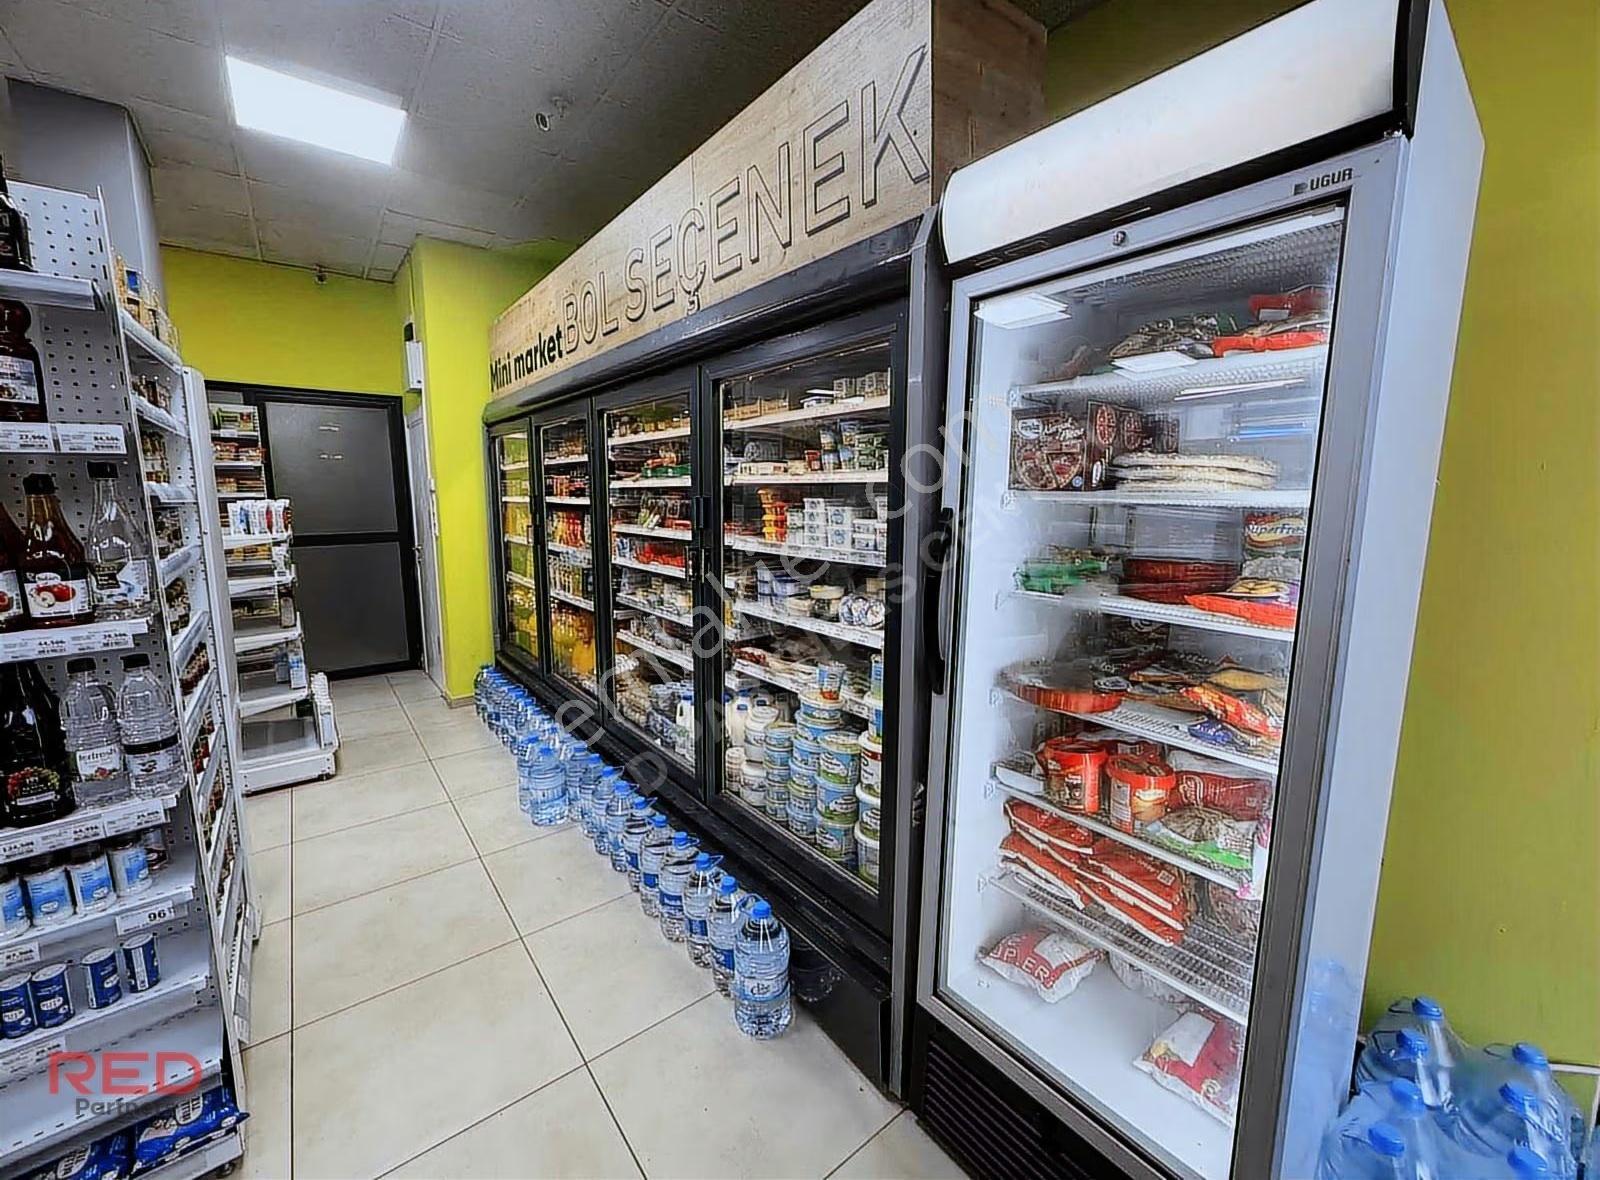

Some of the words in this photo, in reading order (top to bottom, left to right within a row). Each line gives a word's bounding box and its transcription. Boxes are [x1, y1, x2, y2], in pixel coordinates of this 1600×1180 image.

[490, 352, 512, 393] Mini
[514, 324, 563, 381] market
[562, 270, 619, 354] BOL
[624, 45, 930, 316] SEÇENEK
[148, 909, 167, 922] 96
